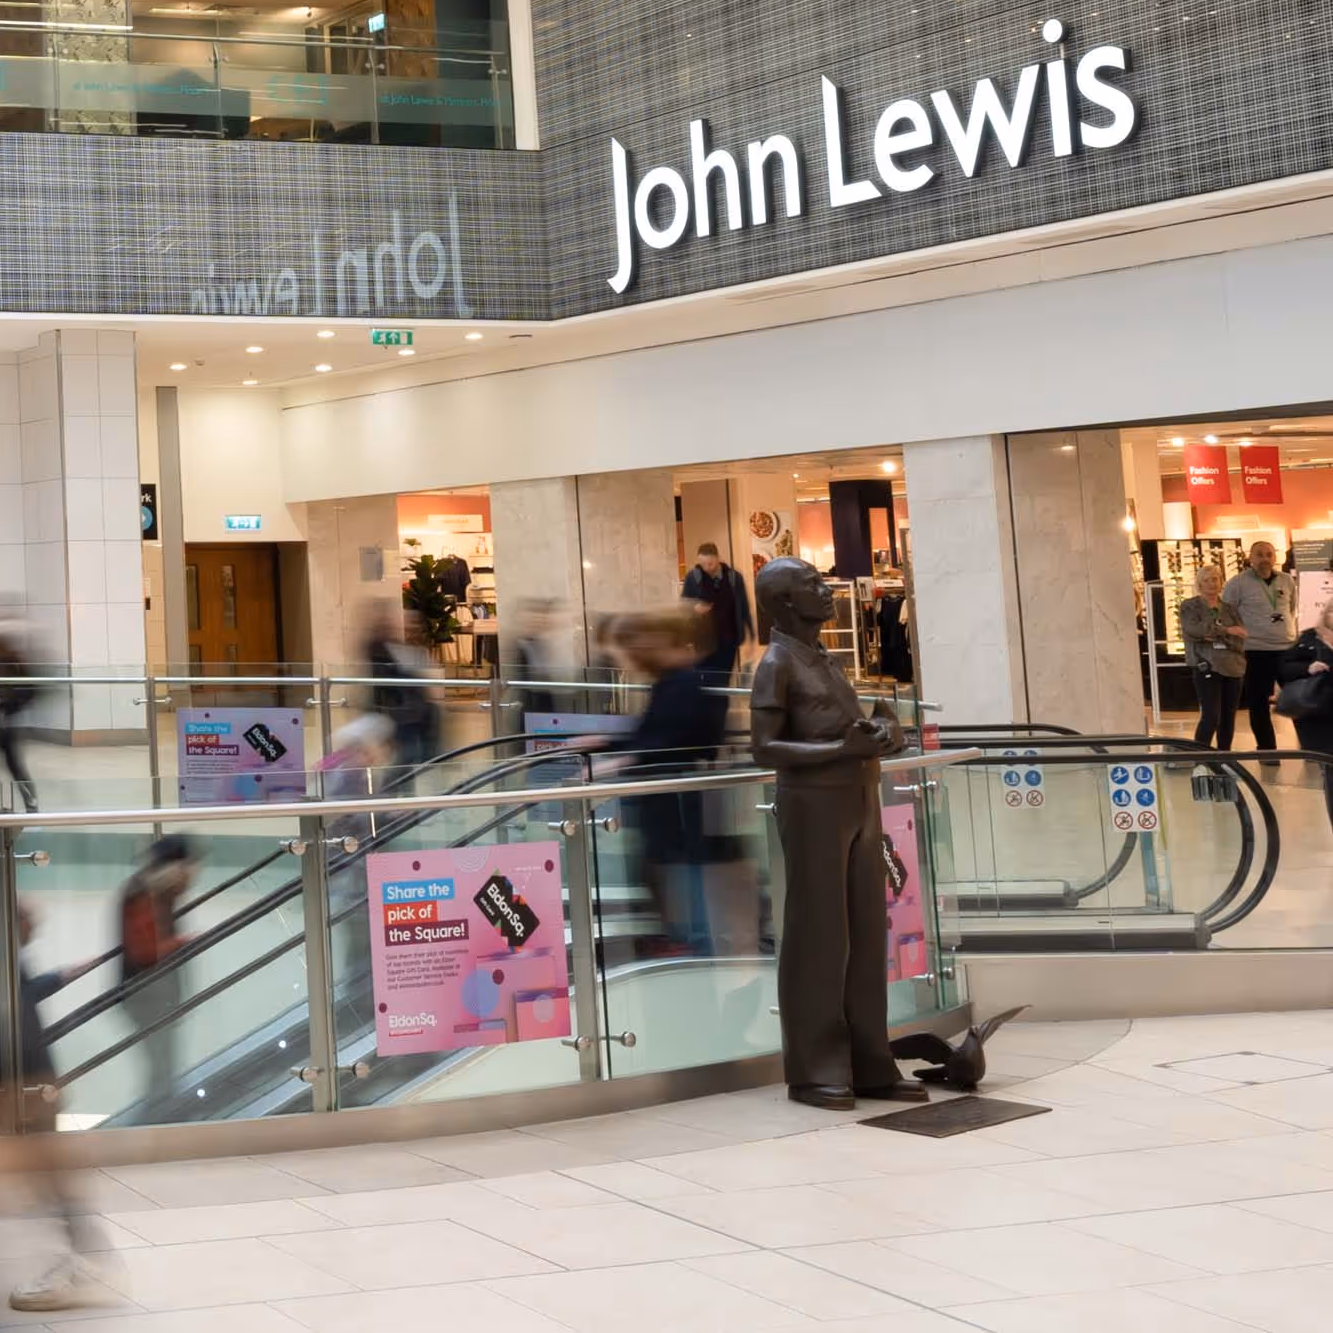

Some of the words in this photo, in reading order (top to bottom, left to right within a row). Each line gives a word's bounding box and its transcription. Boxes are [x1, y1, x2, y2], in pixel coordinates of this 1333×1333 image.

[607, 119, 803, 295] John
[822, 19, 1138, 209] Lewis
[1189, 465, 1220, 475] Fashion
[1244, 465, 1272, 475] Fashion
[1190, 477, 1215, 486] Offers
[1246, 477, 1268, 485] Offers
[188, 735, 206, 745] pick
[207, 735, 217, 743] of
[188, 746, 203, 754] the
[204, 745, 238, 755] Square!
[387, 885, 426, 901] Share
[428, 883, 450, 897] the
[387, 907, 415, 924] pick
[419, 904, 433, 918] of
[486, 882, 526, 938] EldonSq.
[388, 928, 411, 942] the
[414, 923, 466, 943] Square!
[388, 1012, 438, 1028] EldonSq.
